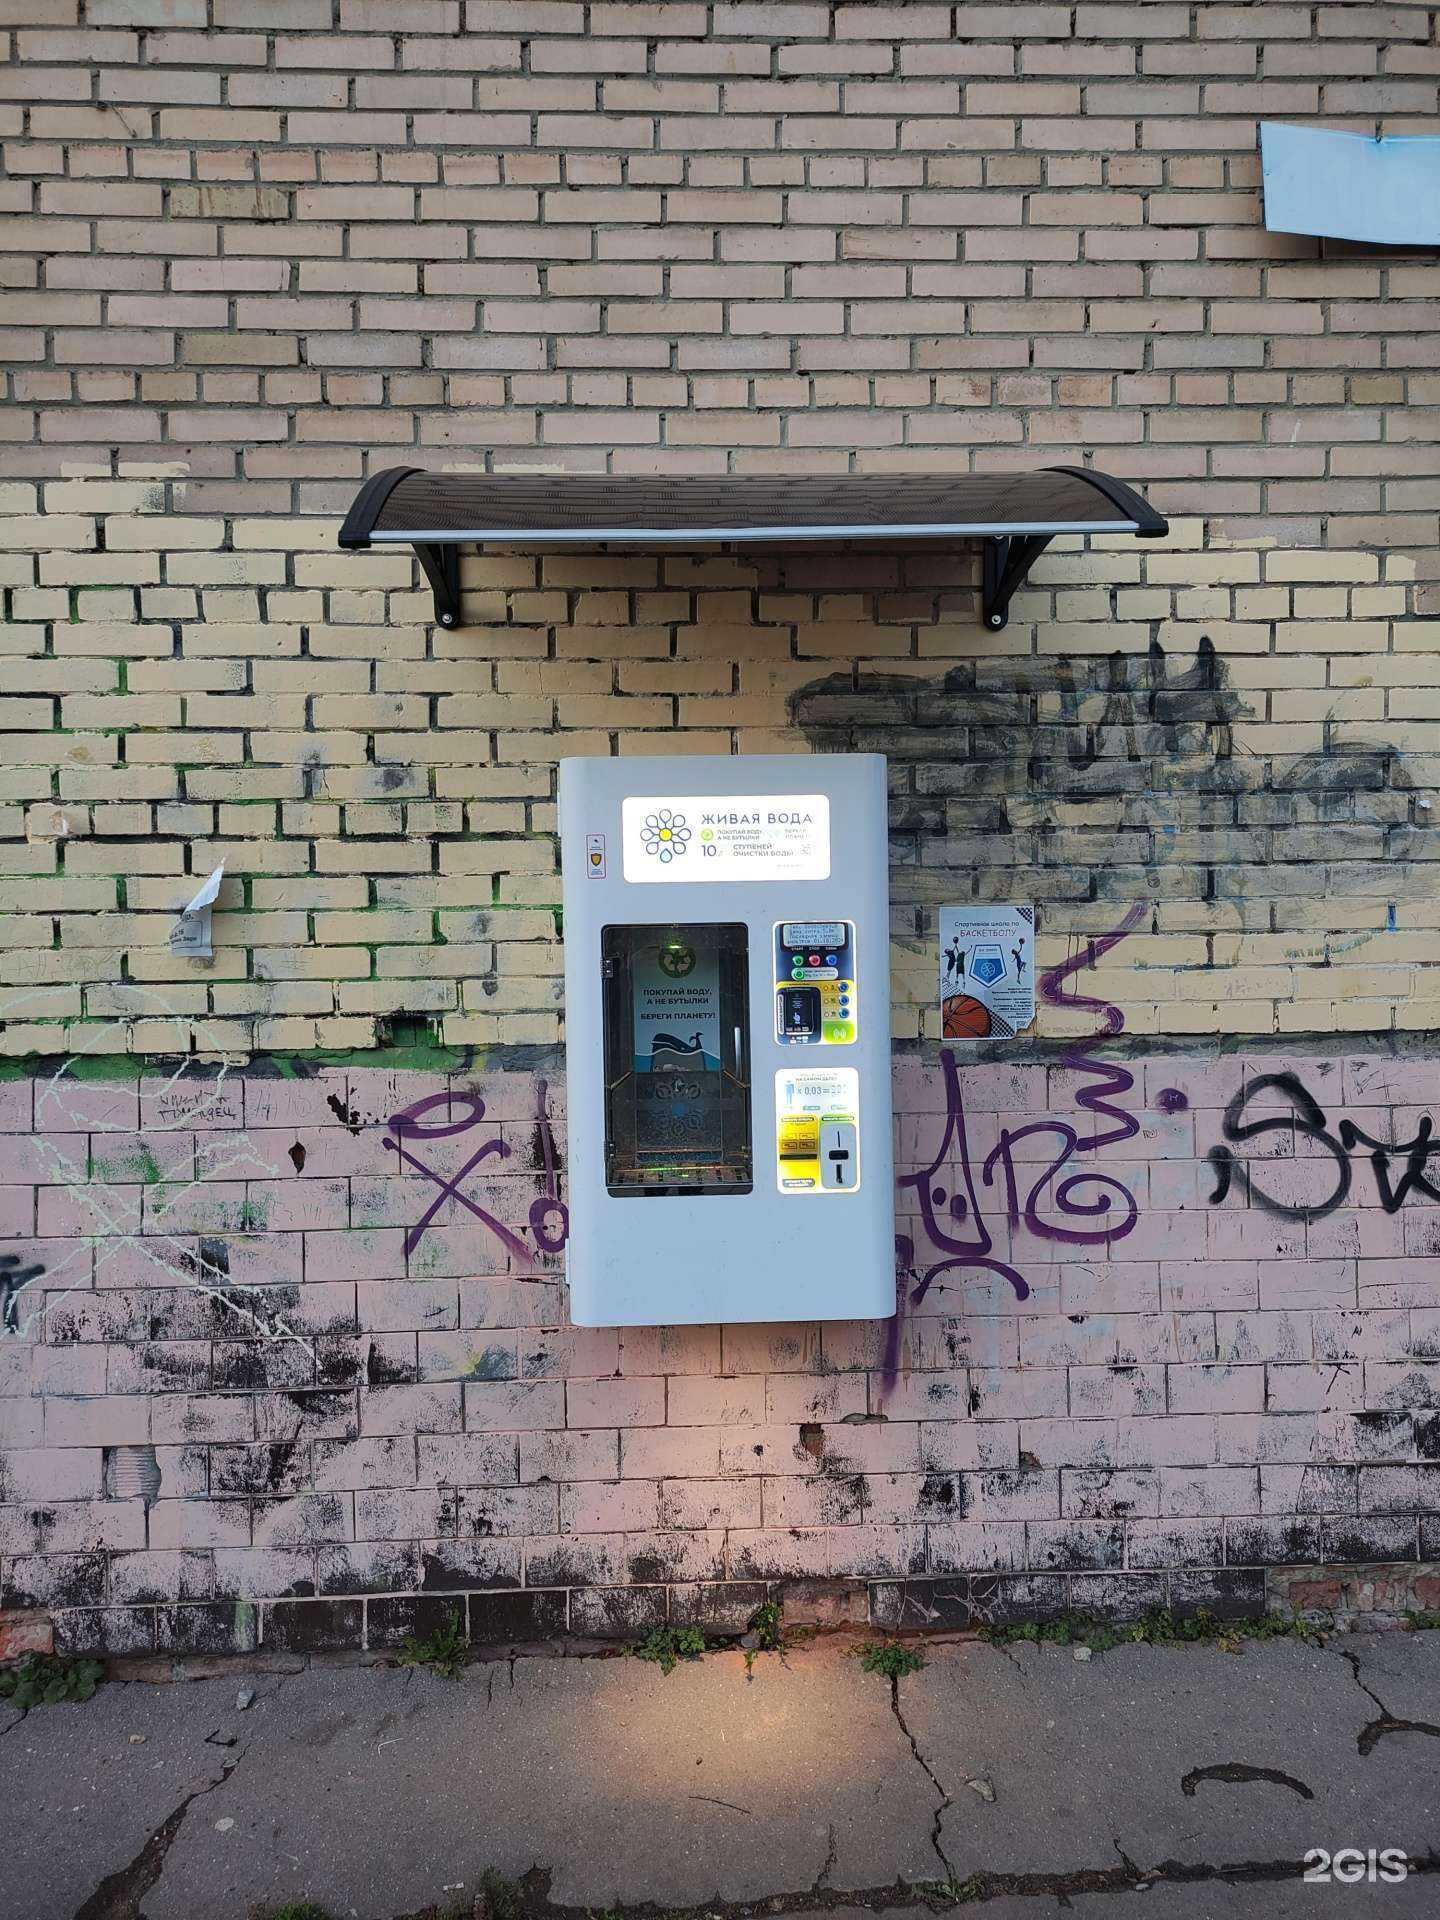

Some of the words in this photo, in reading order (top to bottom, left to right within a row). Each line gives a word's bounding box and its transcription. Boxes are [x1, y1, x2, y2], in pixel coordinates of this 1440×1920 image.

[701, 814, 760, 825] ЖИВАЯ
[768, 813, 813, 825] ВОДА
[733, 842, 772, 850] СТУПЕНЕЙ
[701, 844, 717, 857] 10
[960, 929, 1017, 937] БАСКЕТБОЛУ
[643, 988, 684, 996] ПОКУПАЙ
[668, 996, 709, 1005] БУТЫЛКИ
[640, 1012, 672, 1020] БЕРЕГИ
[674, 1012, 716, 1020] ПЛАНЕТУ!
[804, 1086, 822, 1096] 0,03
